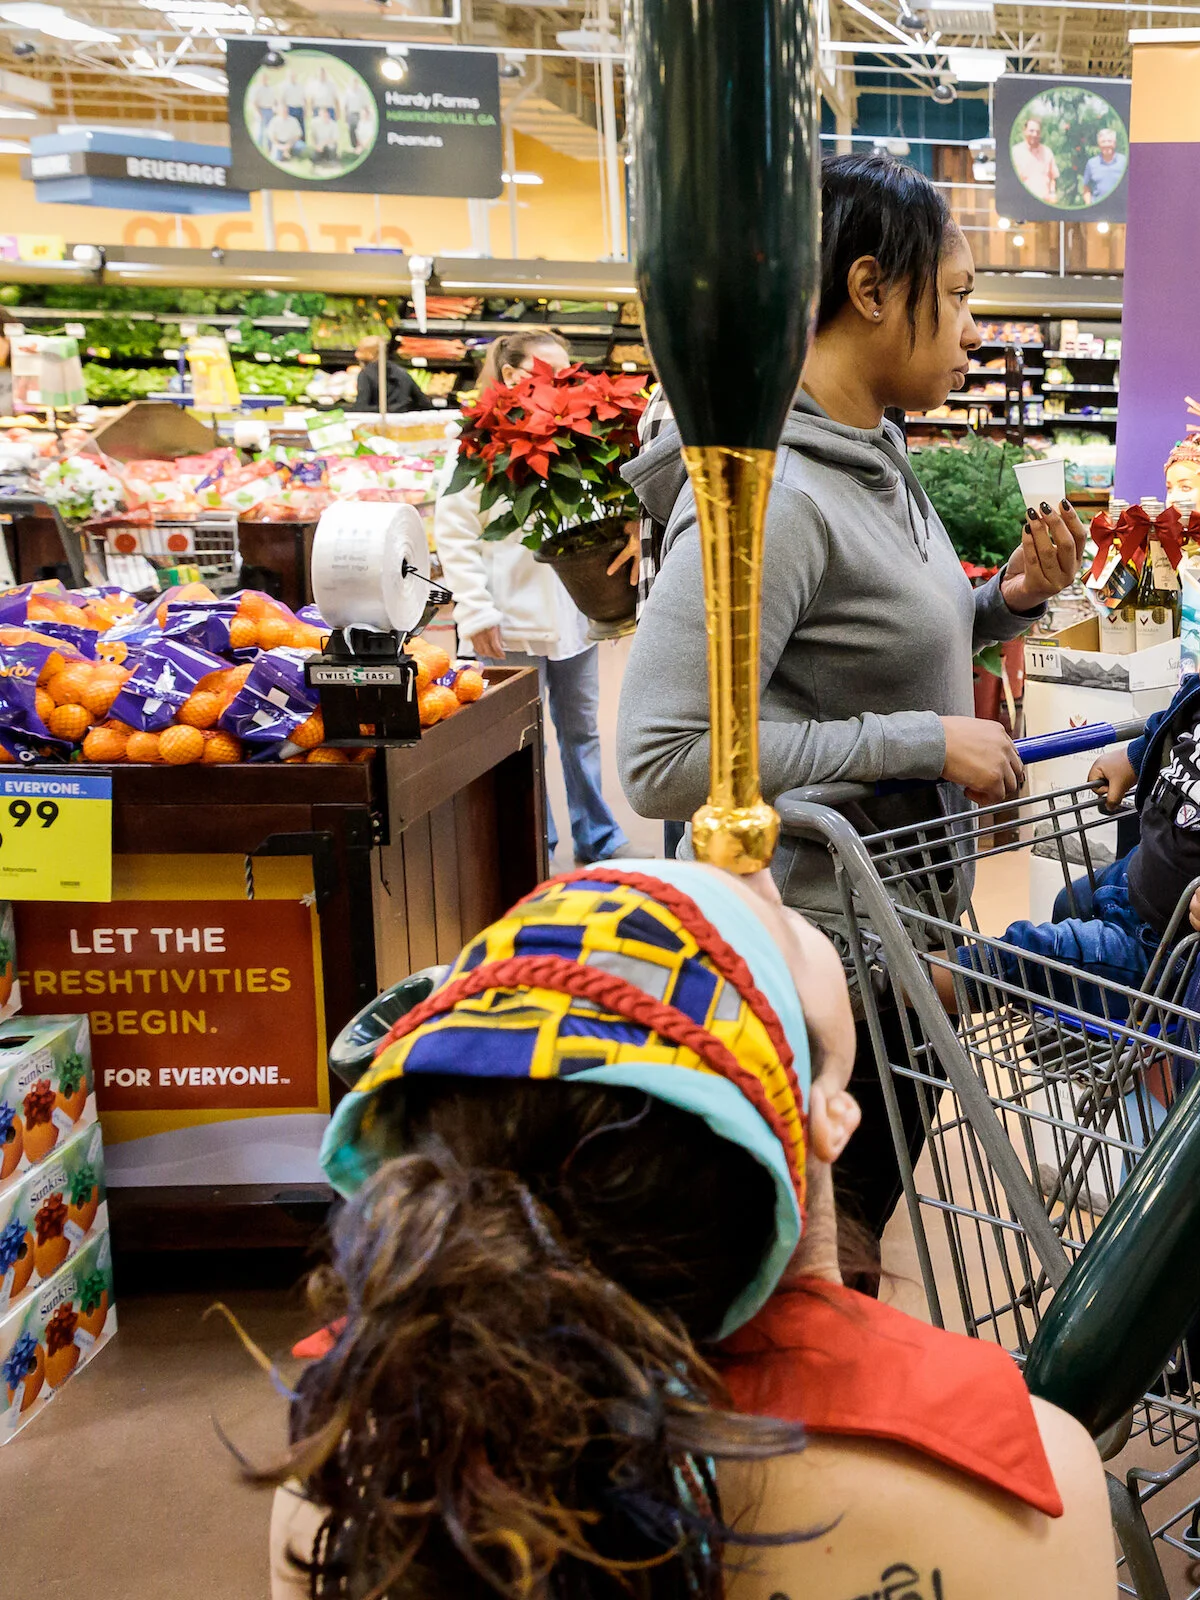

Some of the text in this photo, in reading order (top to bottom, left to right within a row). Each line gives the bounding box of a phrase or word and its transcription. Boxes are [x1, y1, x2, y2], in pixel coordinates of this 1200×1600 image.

[385, 90, 480, 110] Hardy Farms
[387, 132, 444, 147] Peanuts
[126, 155, 226, 187] BEVERAGE
[319, 672, 392, 681] TWIST EASE
[70, 926, 227, 955] LET THE
[90, 1010, 218, 1035] BEGIN.
[18, 1057, 56, 1088] Sunkist
[104, 1068, 151, 1088] FOR
[30, 1171, 67, 1204] Sunkist
[40, 1281, 78, 1317] Sunkist
